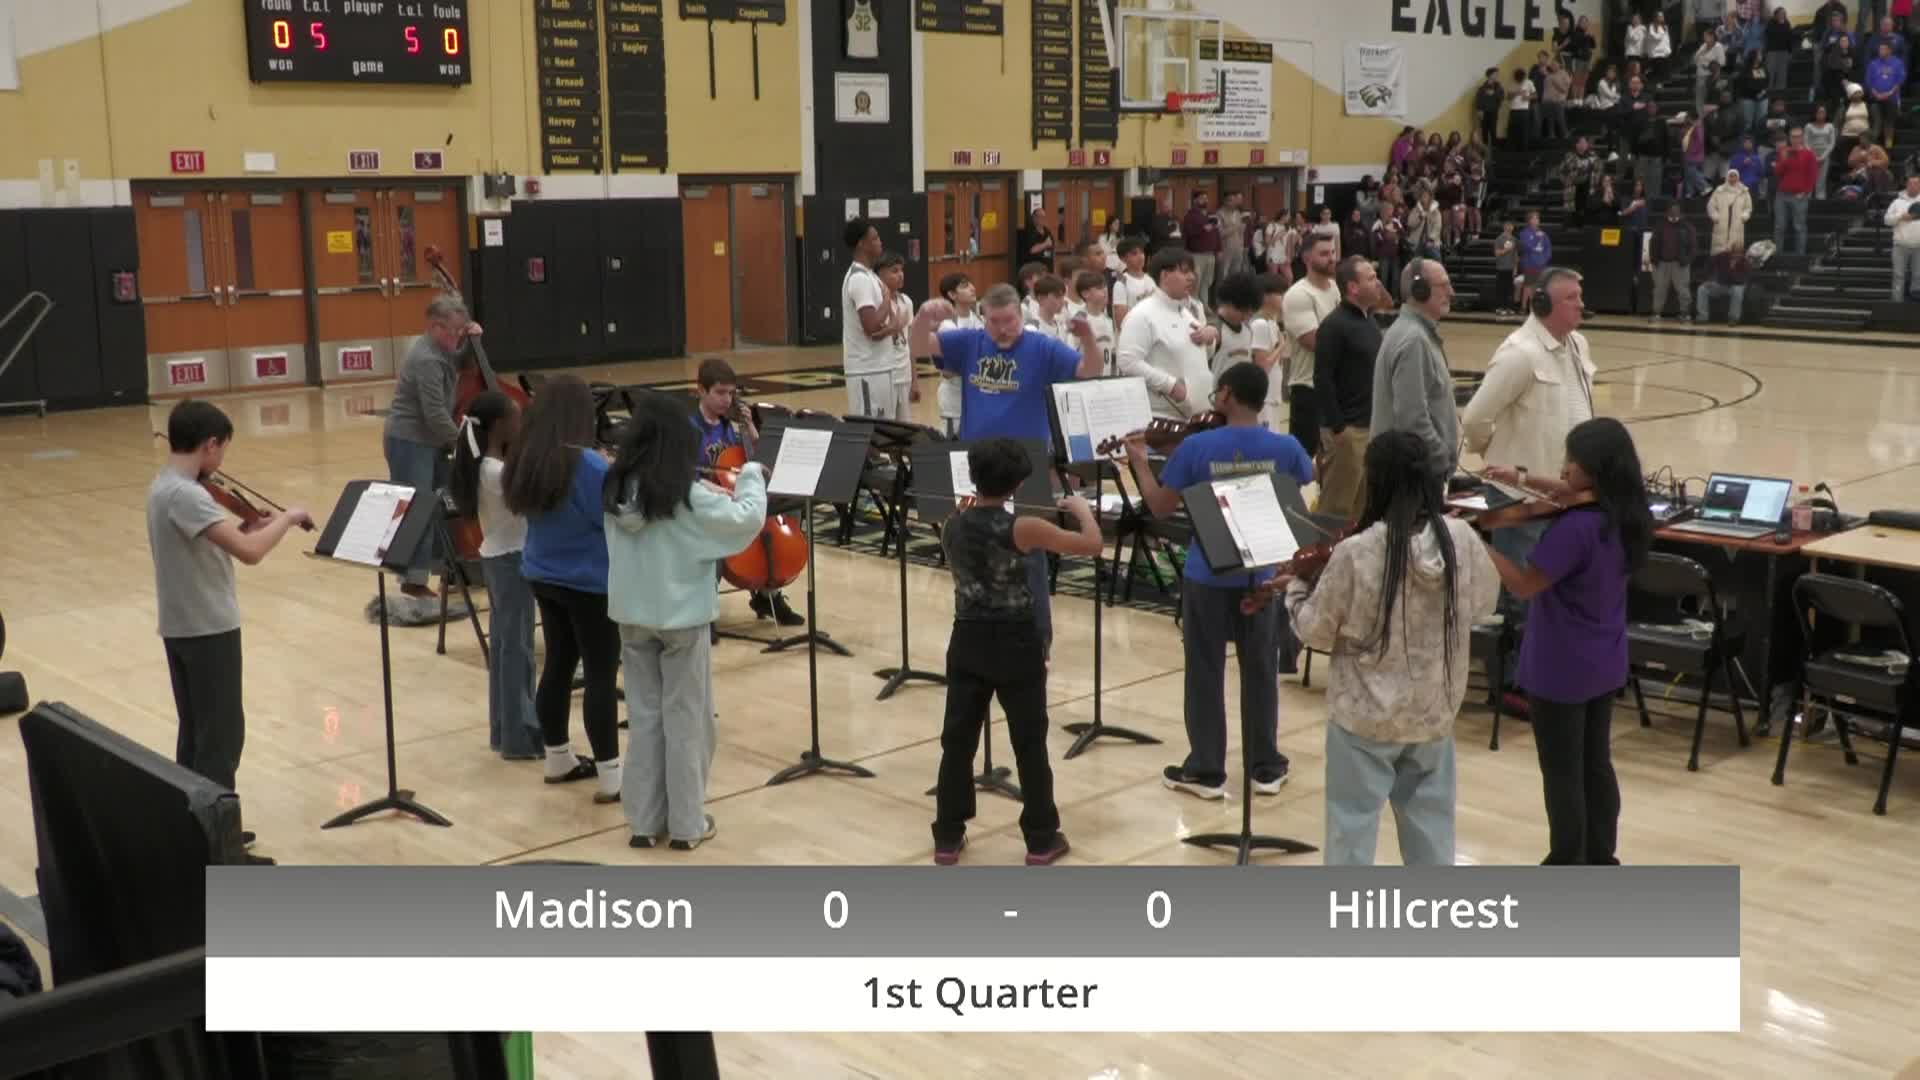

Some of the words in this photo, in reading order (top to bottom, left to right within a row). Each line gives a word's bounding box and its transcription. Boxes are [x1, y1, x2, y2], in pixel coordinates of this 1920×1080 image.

[343, 0, 384, 15] player
[433, 3, 461, 19] fouls
[855, 15, 871, 32] 32
[273, 20, 291, 49] 0
[310, 22, 326, 49] 5
[404, 26, 419, 53] 5
[444, 27, 459, 54] 0
[268, 58, 293, 71] won
[352, 60, 384, 76] game
[439, 63, 461, 75] won
[175, 153, 201, 171] EXIT
[354, 152, 376, 168] EXIT
[346, 353, 368, 369] EXIT
[175, 365, 201, 383] EXIT
